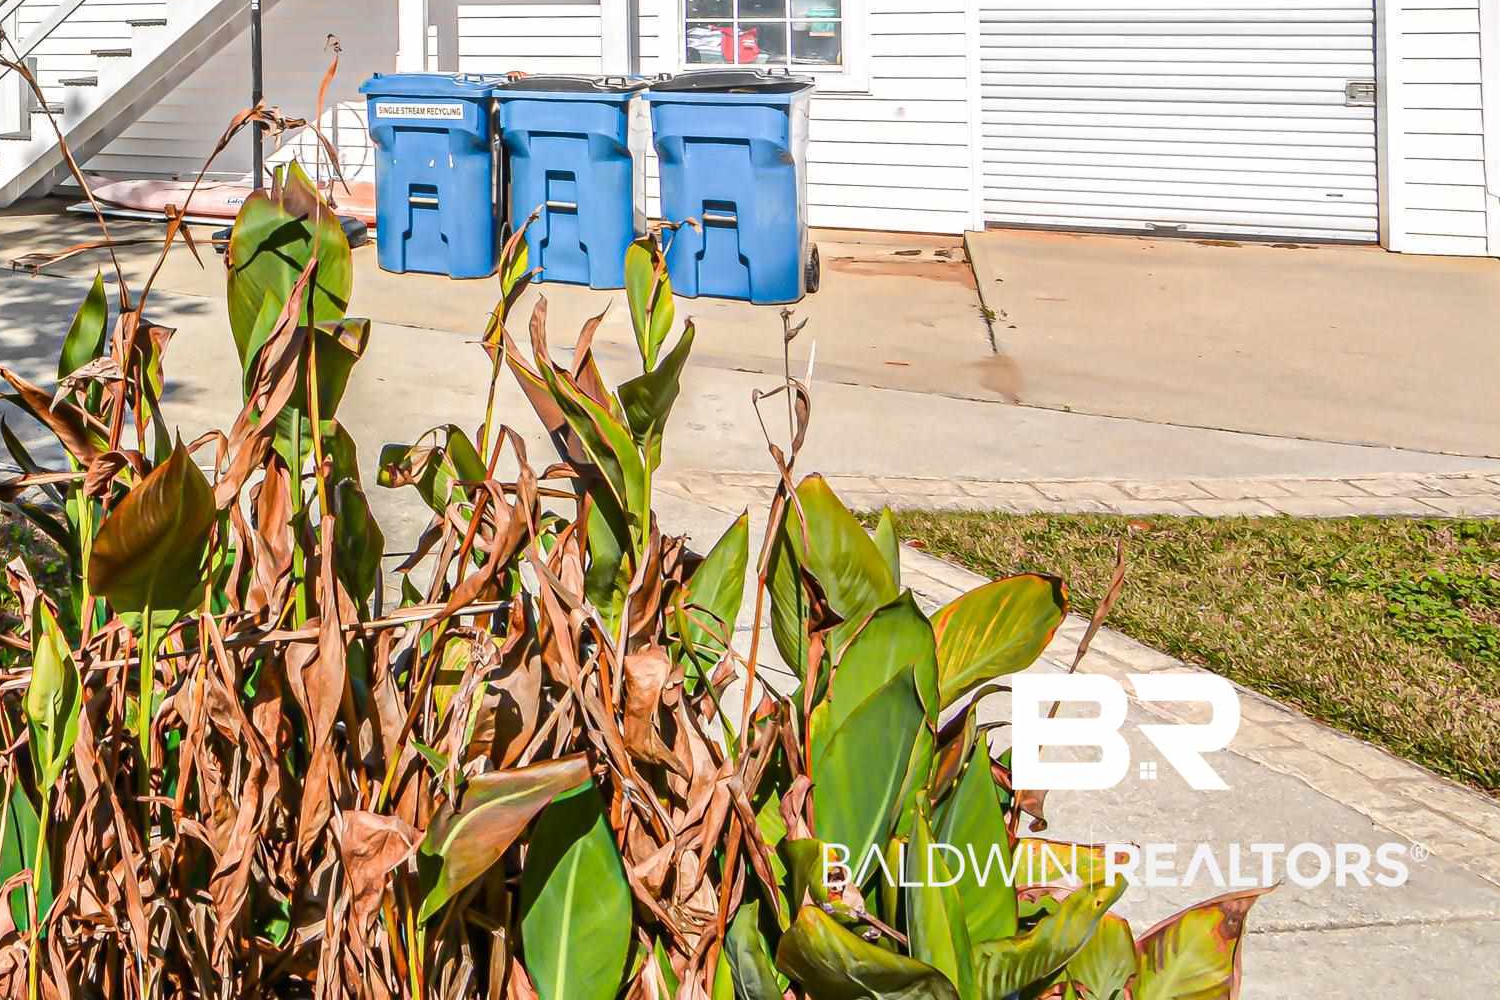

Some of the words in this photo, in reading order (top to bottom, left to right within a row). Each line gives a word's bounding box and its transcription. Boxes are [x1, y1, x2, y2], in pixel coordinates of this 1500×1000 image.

[379, 106, 400, 115] SINGLE
[400, 107, 425, 115] STREAM
[426, 107, 461, 116] RECYCLING
